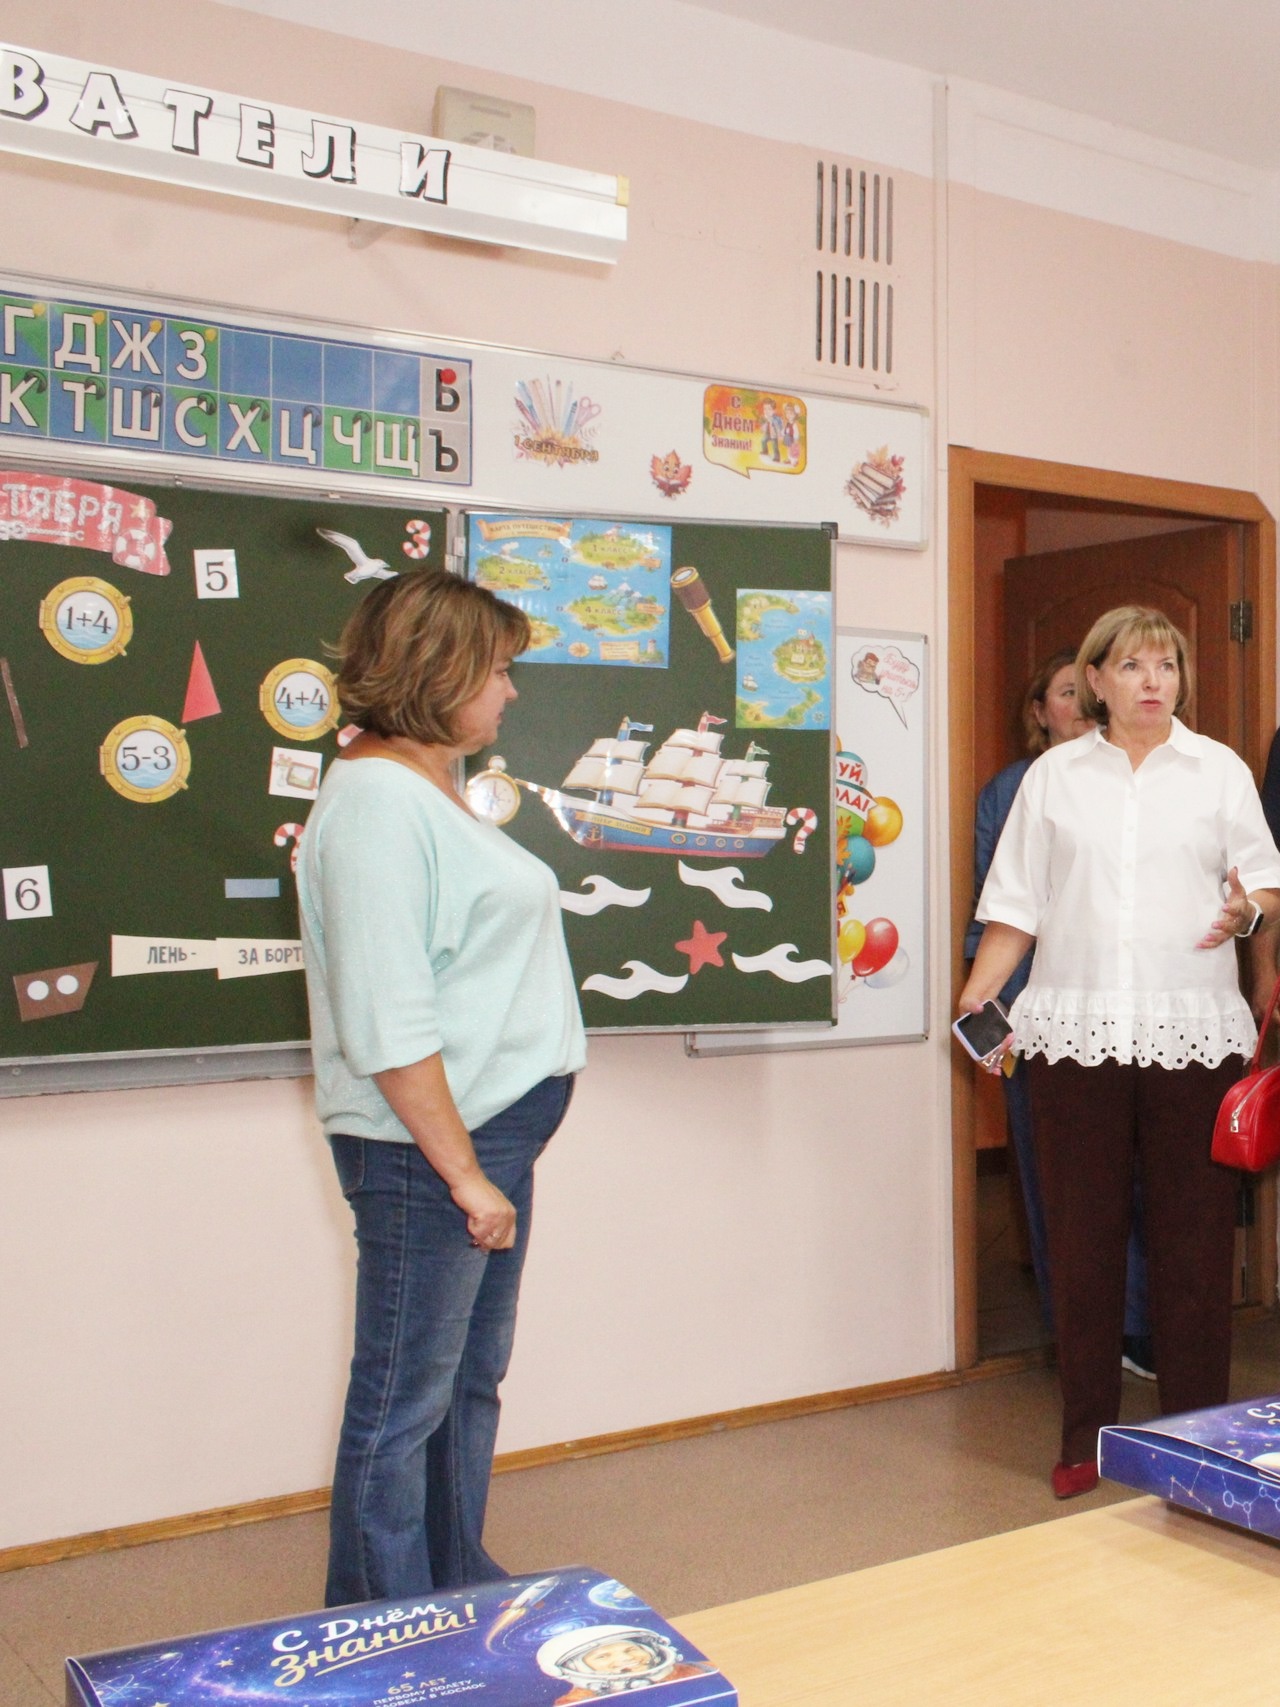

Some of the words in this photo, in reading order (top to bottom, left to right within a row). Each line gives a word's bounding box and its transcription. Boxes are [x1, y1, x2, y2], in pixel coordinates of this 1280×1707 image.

[205, 561, 229, 592] 5
[65, 606, 112, 635] 1+4
[276, 685, 328, 712] 4+4
[120, 746, 173, 771] 5-3
[15, 878, 41, 911] 6
[238, 949, 259, 965] ЗА
[1247, 1408, 1275, 1419] С
[272, 1630, 309, 1652] С
[319, 1603, 447, 1642] Днём
[373, 1690, 425, 1706] ПЕРВОМУ
[387, 1683, 414, 1695] 65
[420, 1677, 446, 1688] ЛЕТ
[441, 1682, 487, 1696] КОСМОС
